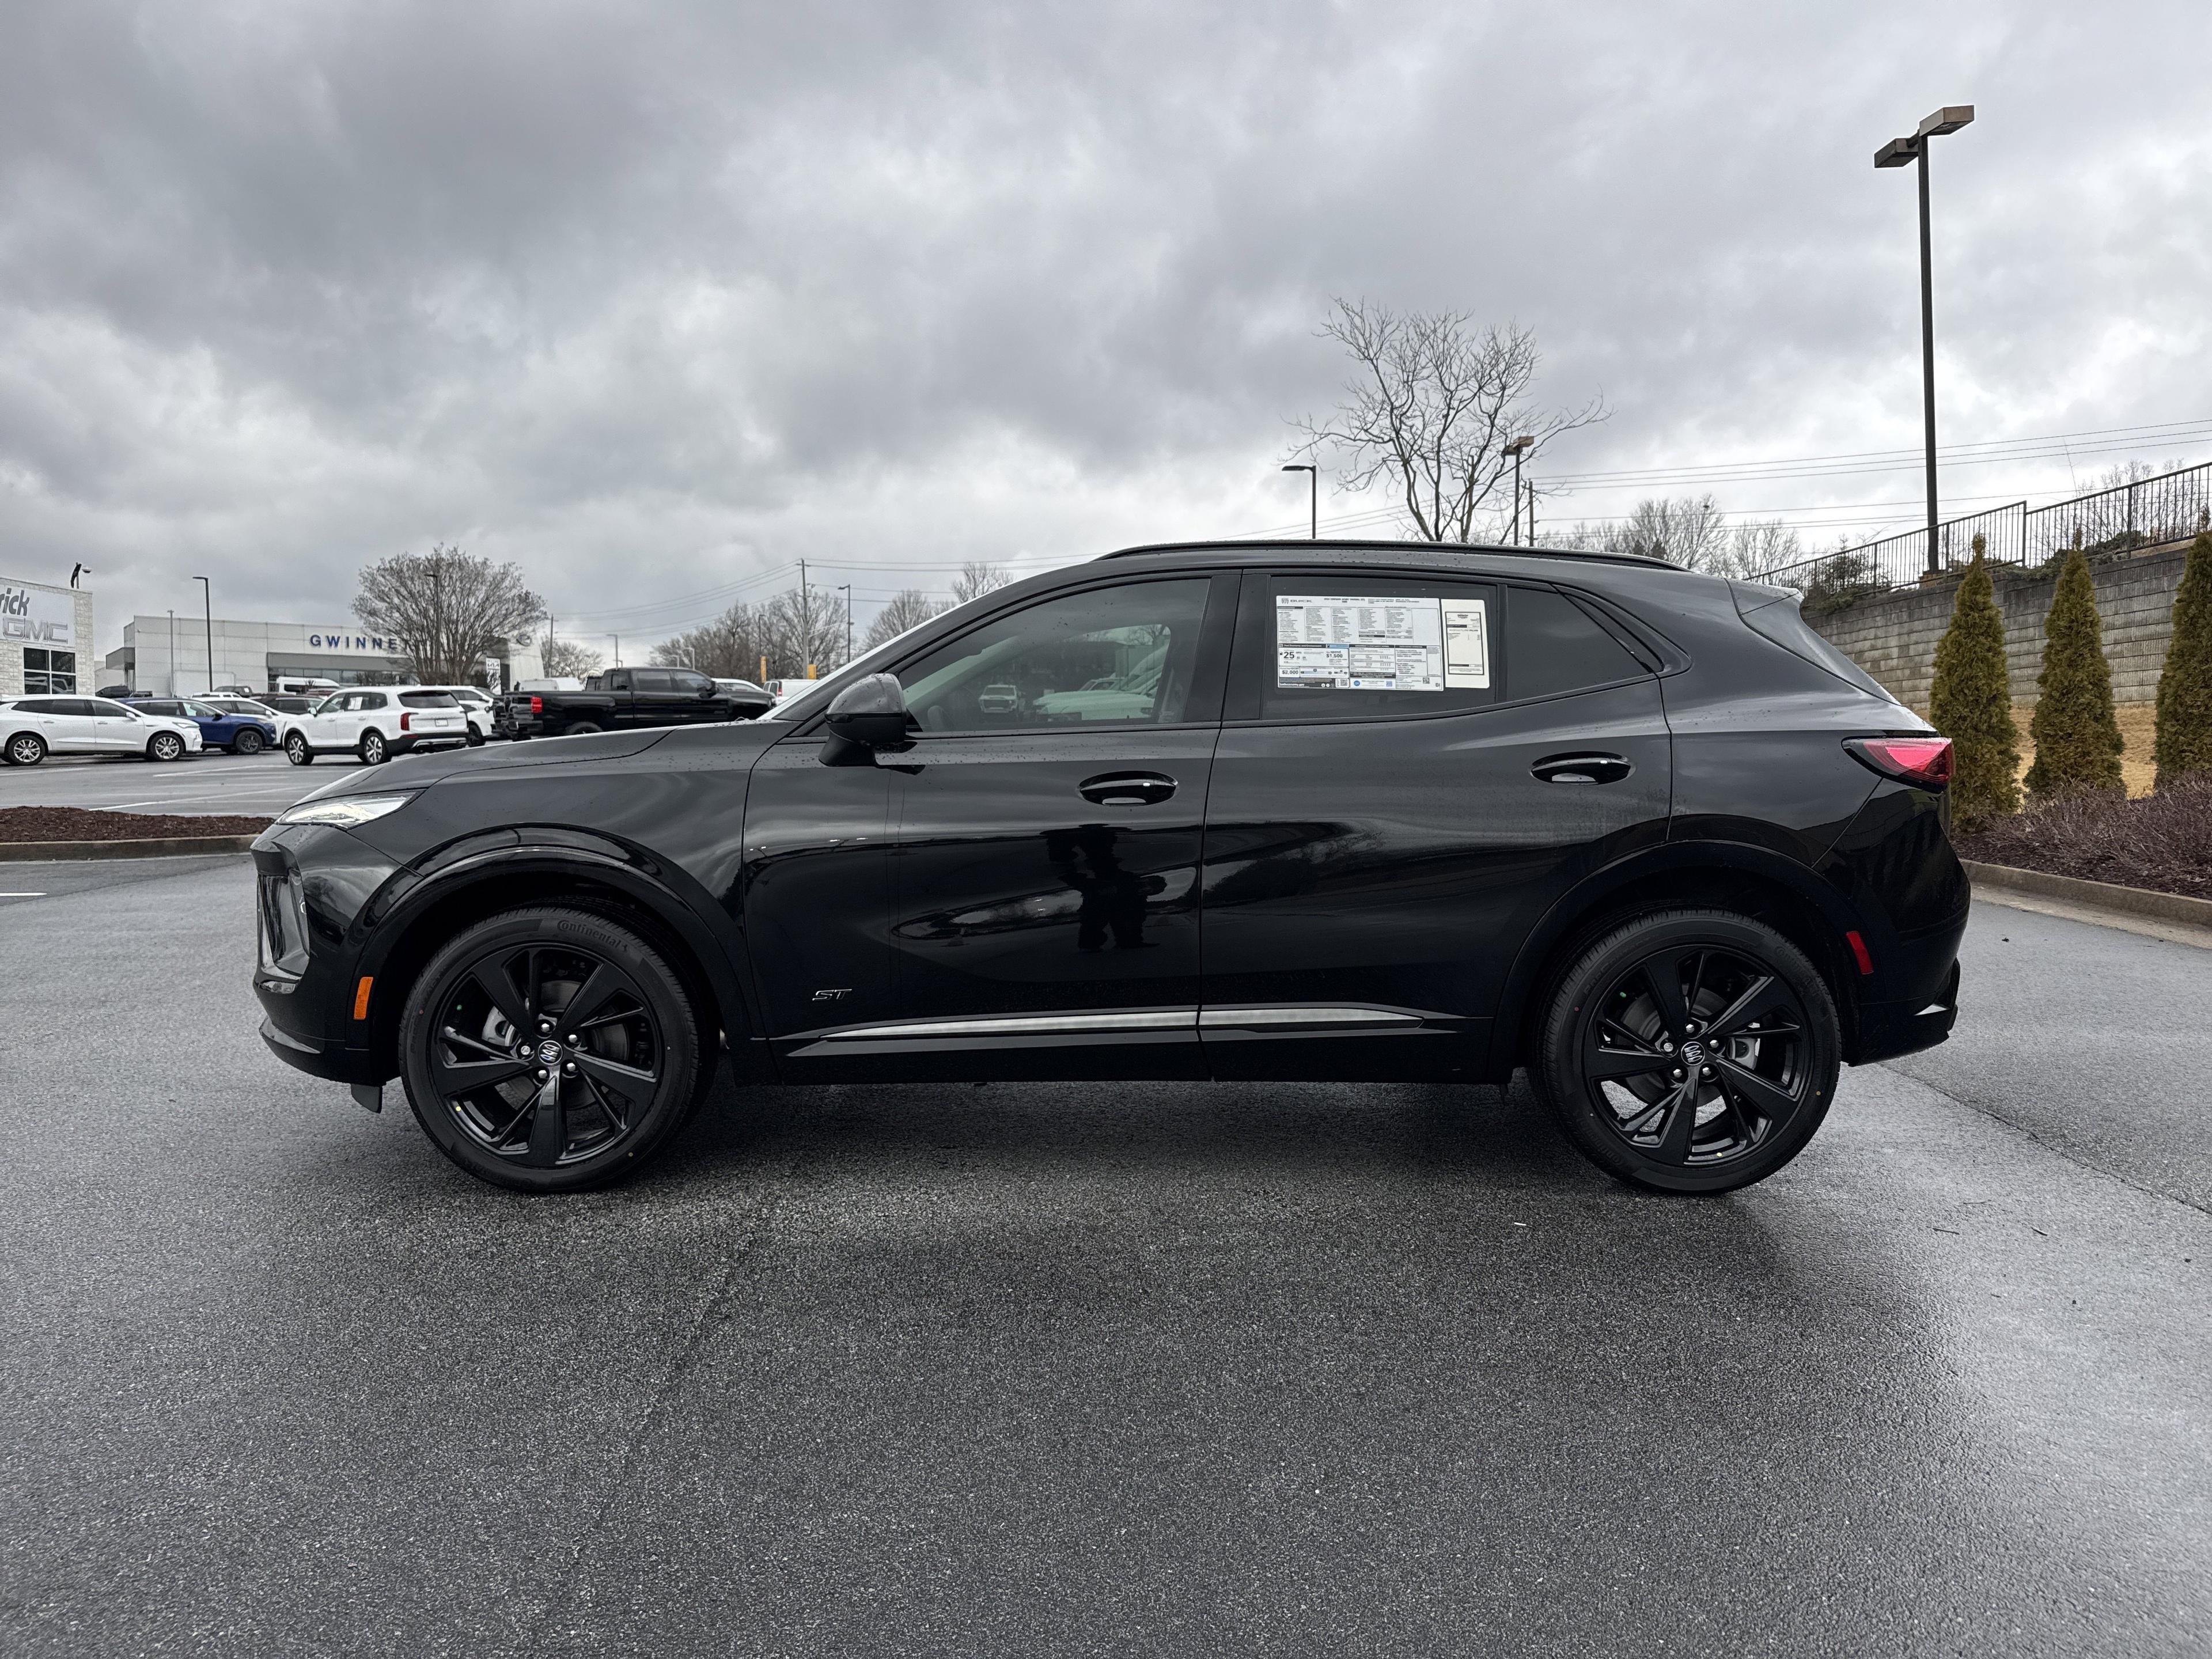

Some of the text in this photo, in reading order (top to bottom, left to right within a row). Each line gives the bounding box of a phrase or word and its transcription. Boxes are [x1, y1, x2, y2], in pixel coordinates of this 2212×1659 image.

[3, 617, 68, 644] GMC
[557, 920, 622, 948] Continental
[812, 988, 853, 1001] ST
